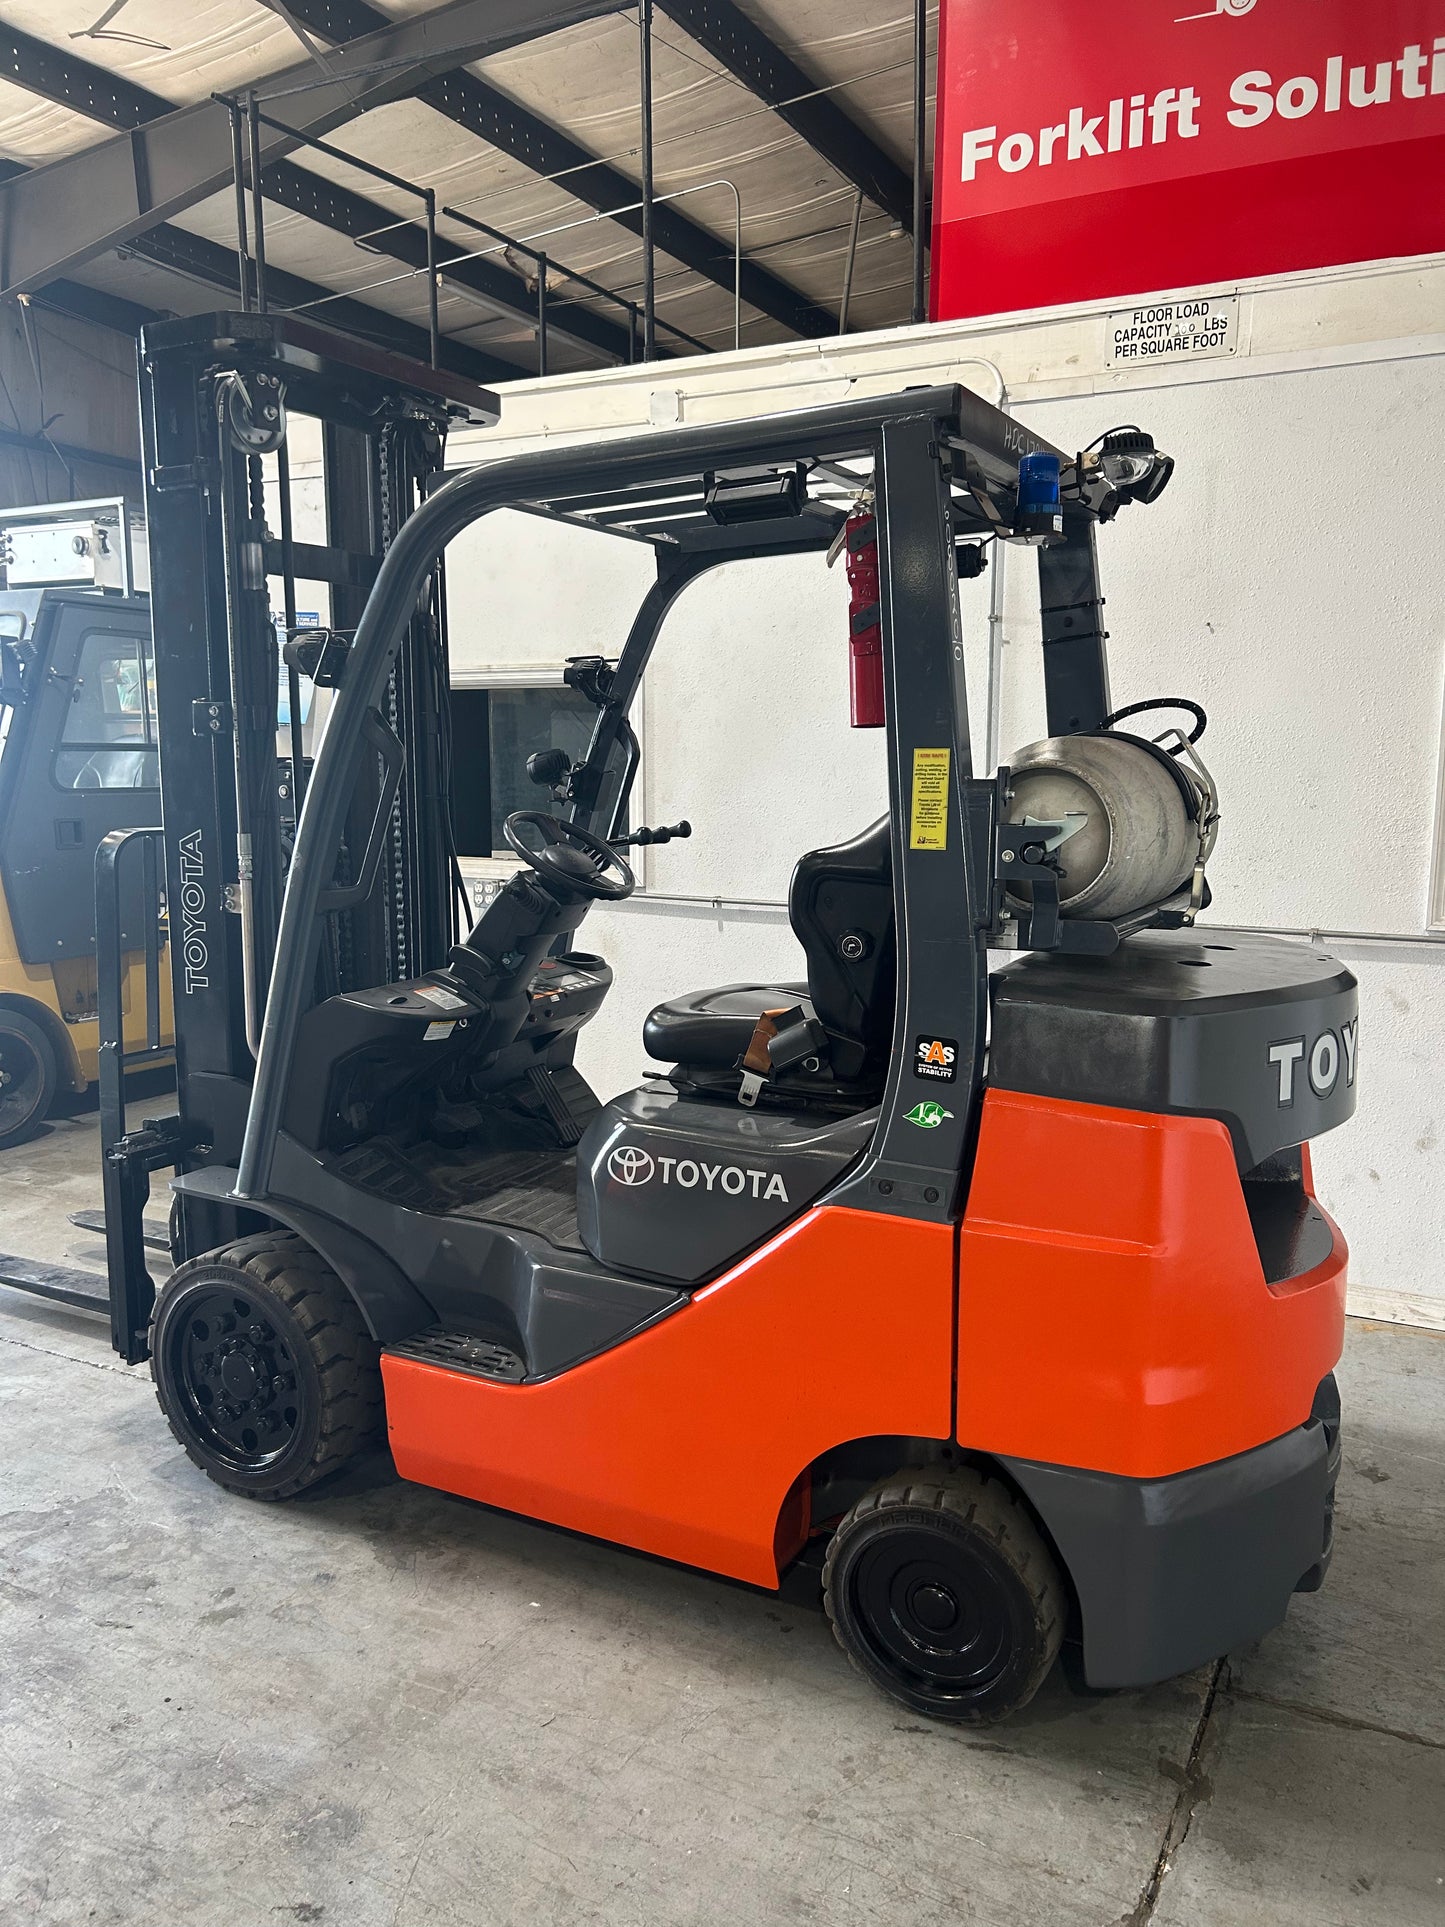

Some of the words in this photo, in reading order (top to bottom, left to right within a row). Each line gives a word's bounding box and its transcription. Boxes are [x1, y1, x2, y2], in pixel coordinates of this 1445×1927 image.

[960, 86, 1201, 183] Forklift
[1226, 37, 1445, 129] Soluti
[1132, 307, 1173, 325] FLOOR
[1176, 302, 1210, 320] LOAD
[1114, 323, 1172, 343] CAPACITY
[1204, 316, 1228, 332] LBS
[1114, 343, 1138, 359] PER
[1140, 336, 1190, 355] SQUARE
[1192, 331, 1227, 349] FOOT
[178, 827, 210, 995] TOYOTA
[917, 1041, 955, 1065] SAS
[1267, 1015, 1359, 1109] TOY
[917, 1067, 953, 1078] STABILITY
[657, 1156, 790, 1203] TOYOTA
